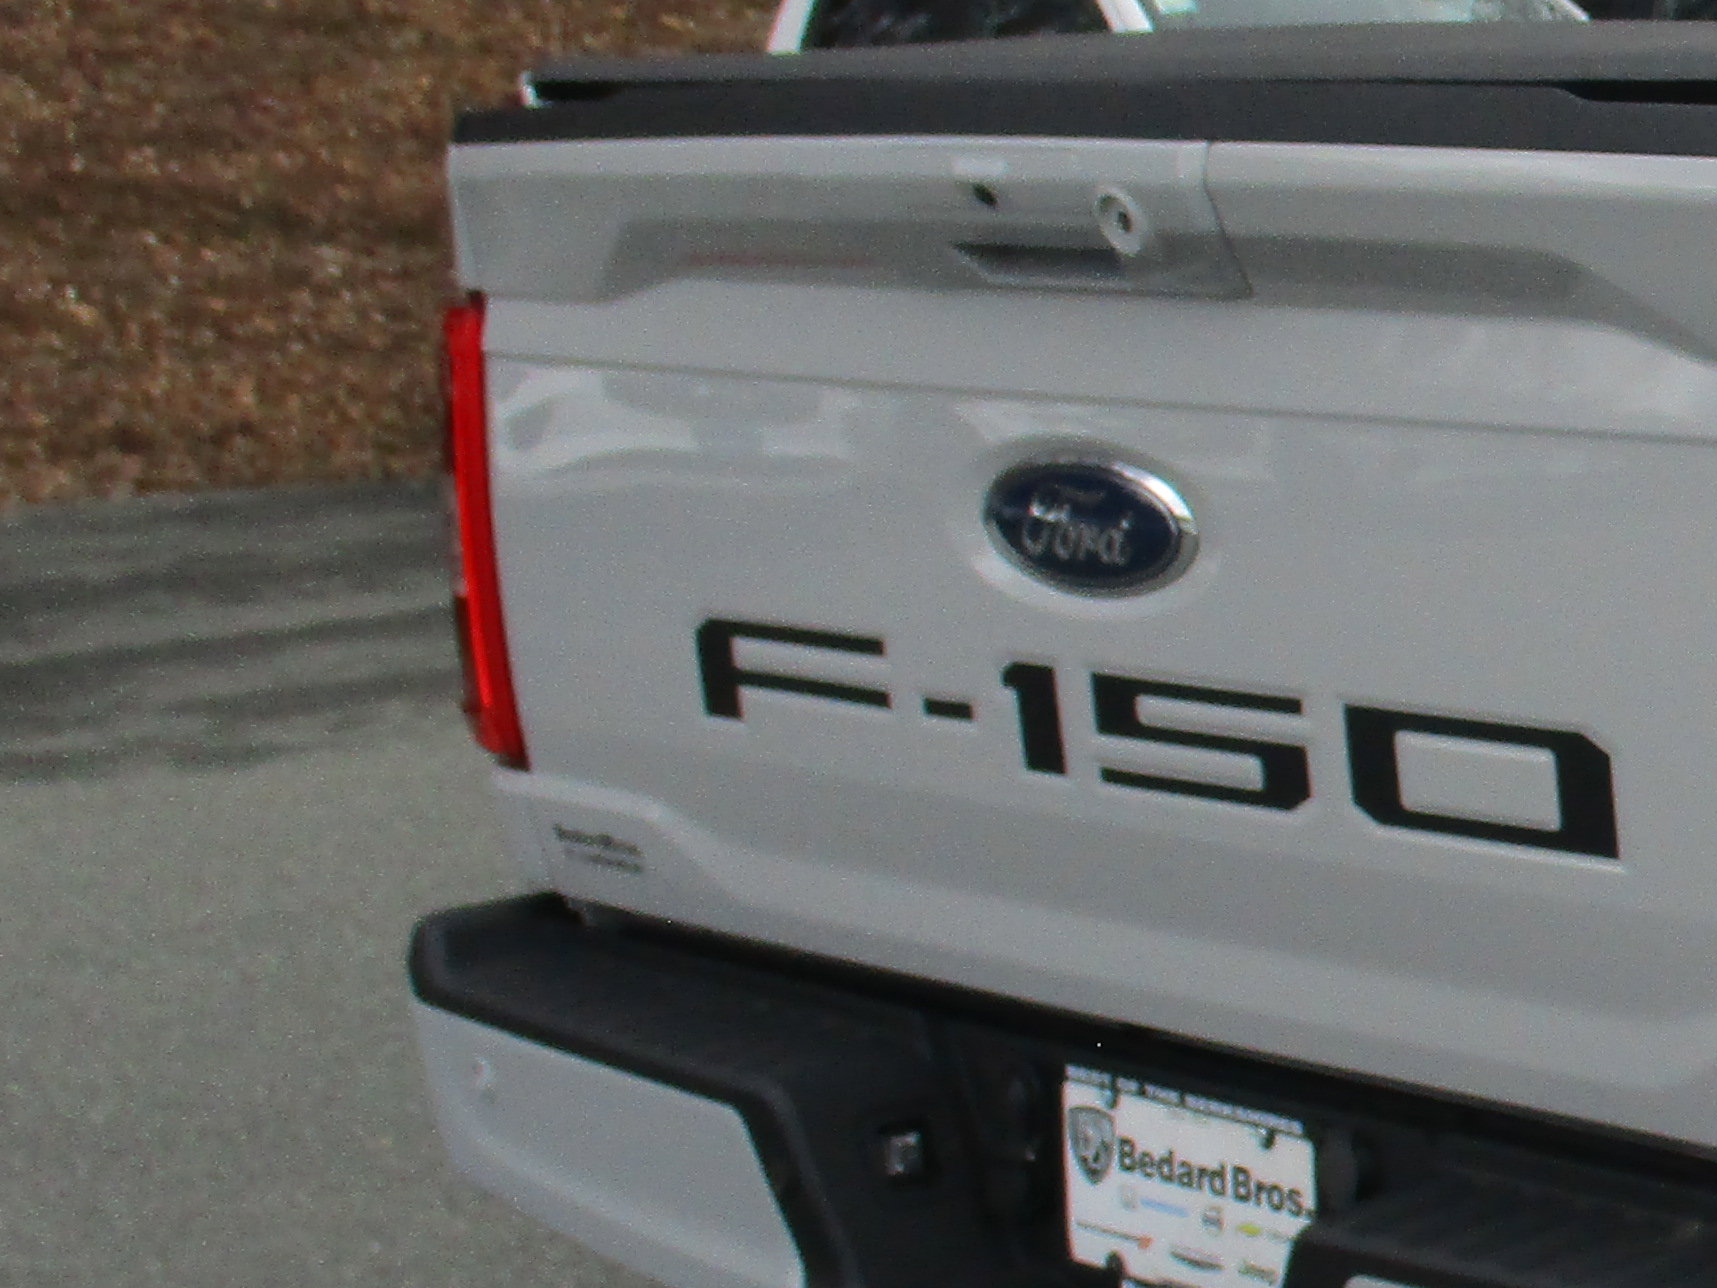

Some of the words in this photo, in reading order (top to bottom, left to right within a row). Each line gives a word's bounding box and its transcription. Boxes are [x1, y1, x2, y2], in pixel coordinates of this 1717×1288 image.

[695, 617, 1621, 861] F-150
[1117, 1135, 1227, 1199] Bedard
[1231, 1165, 1315, 1219] Bros.
